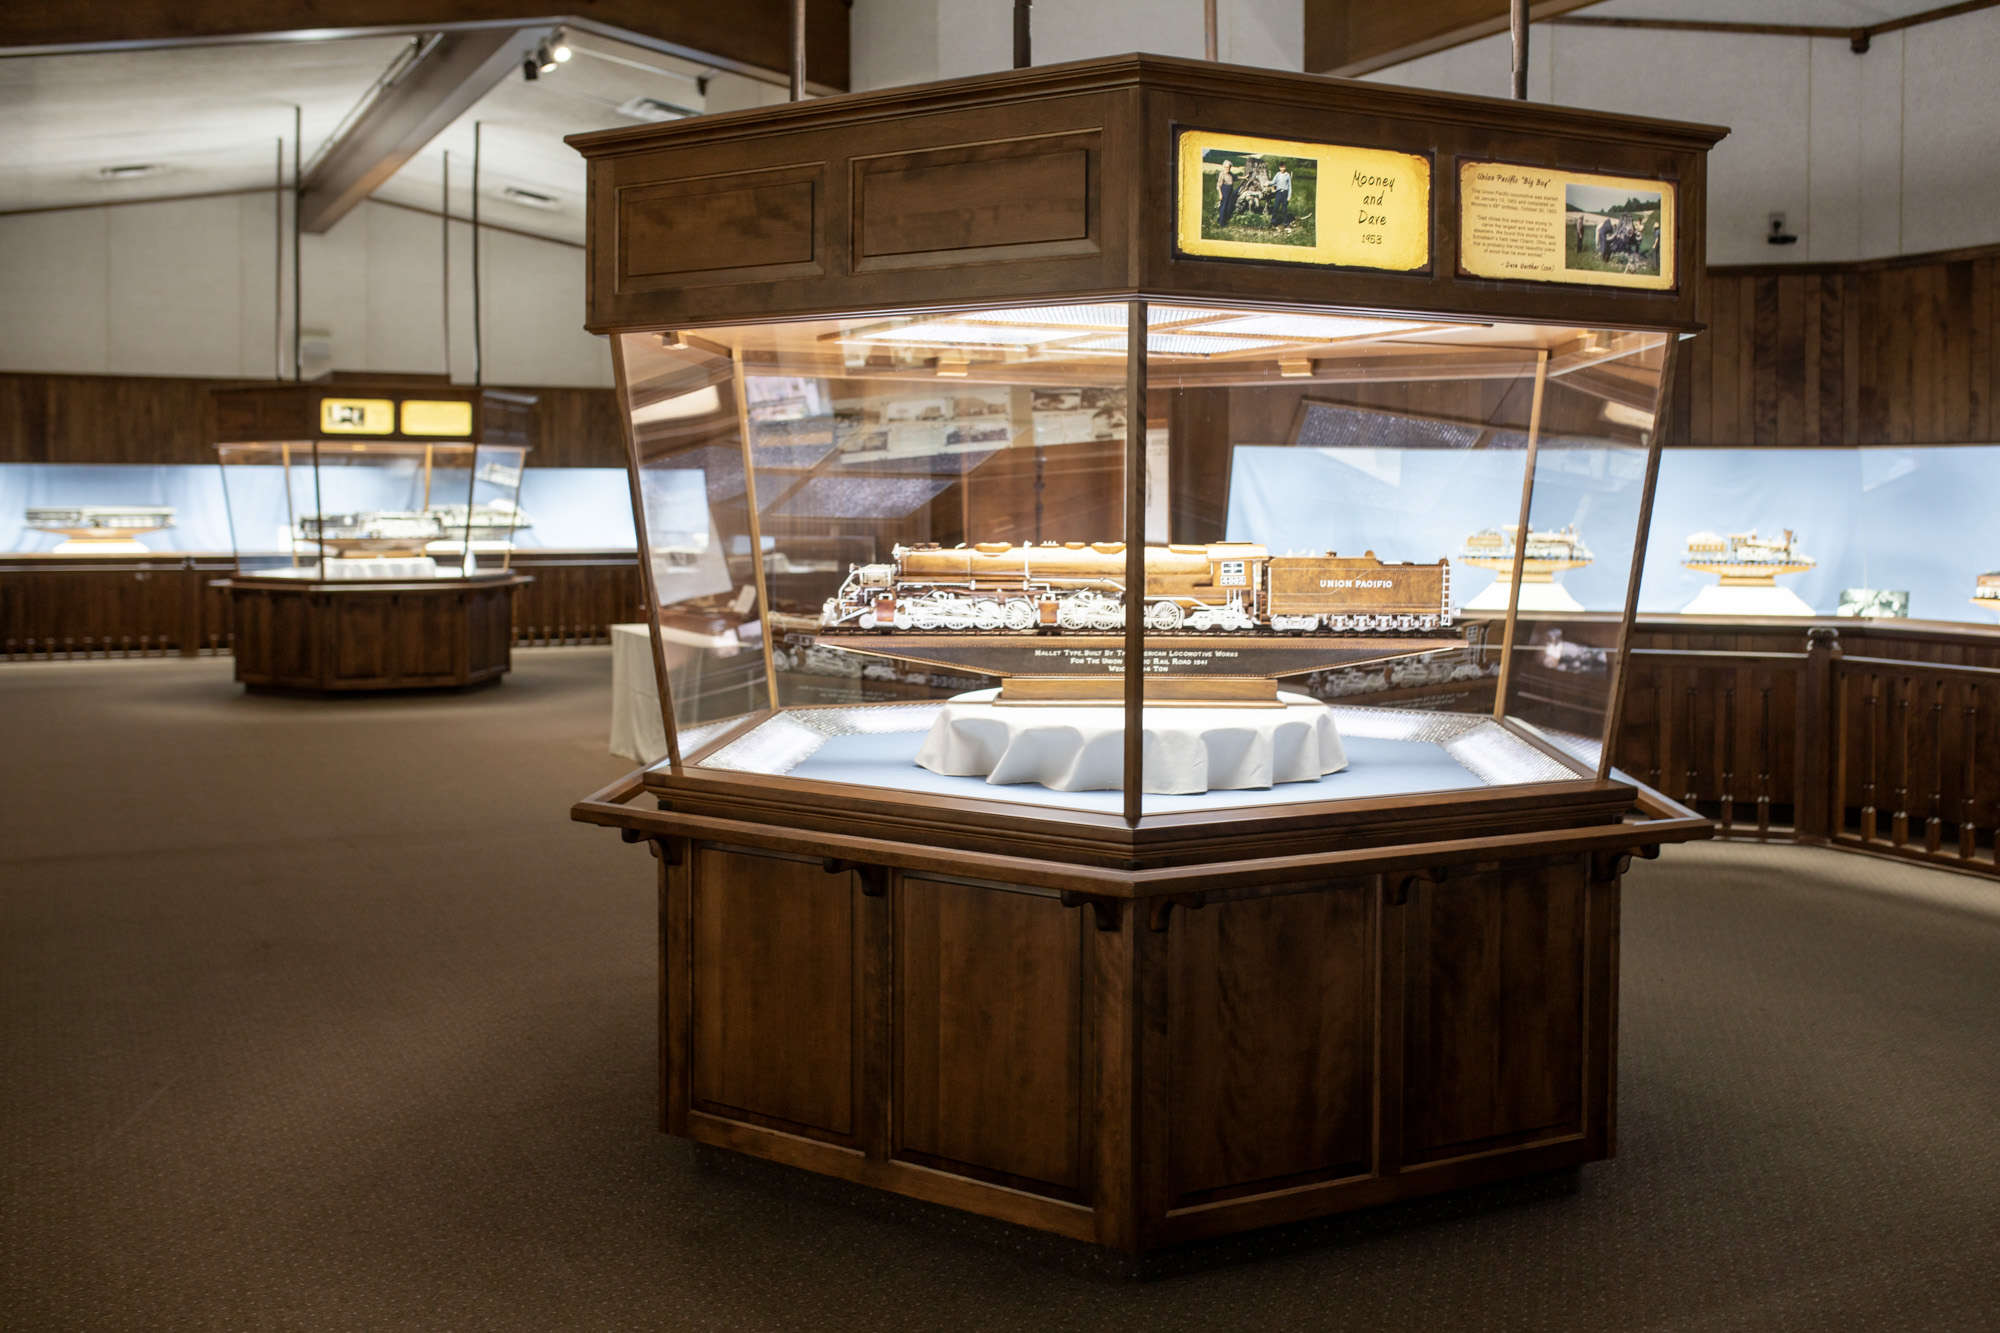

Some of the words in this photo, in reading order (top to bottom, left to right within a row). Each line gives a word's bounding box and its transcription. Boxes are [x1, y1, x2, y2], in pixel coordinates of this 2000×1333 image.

[1351, 169, 1396, 192] Mooney
[1477, 172, 1495, 181] Union
[1496, 174, 1519, 186] Pacific
[1363, 190, 1385, 206] and
[1361, 234, 1383, 244] 1953
[1319, 579, 1353, 588] UNION
